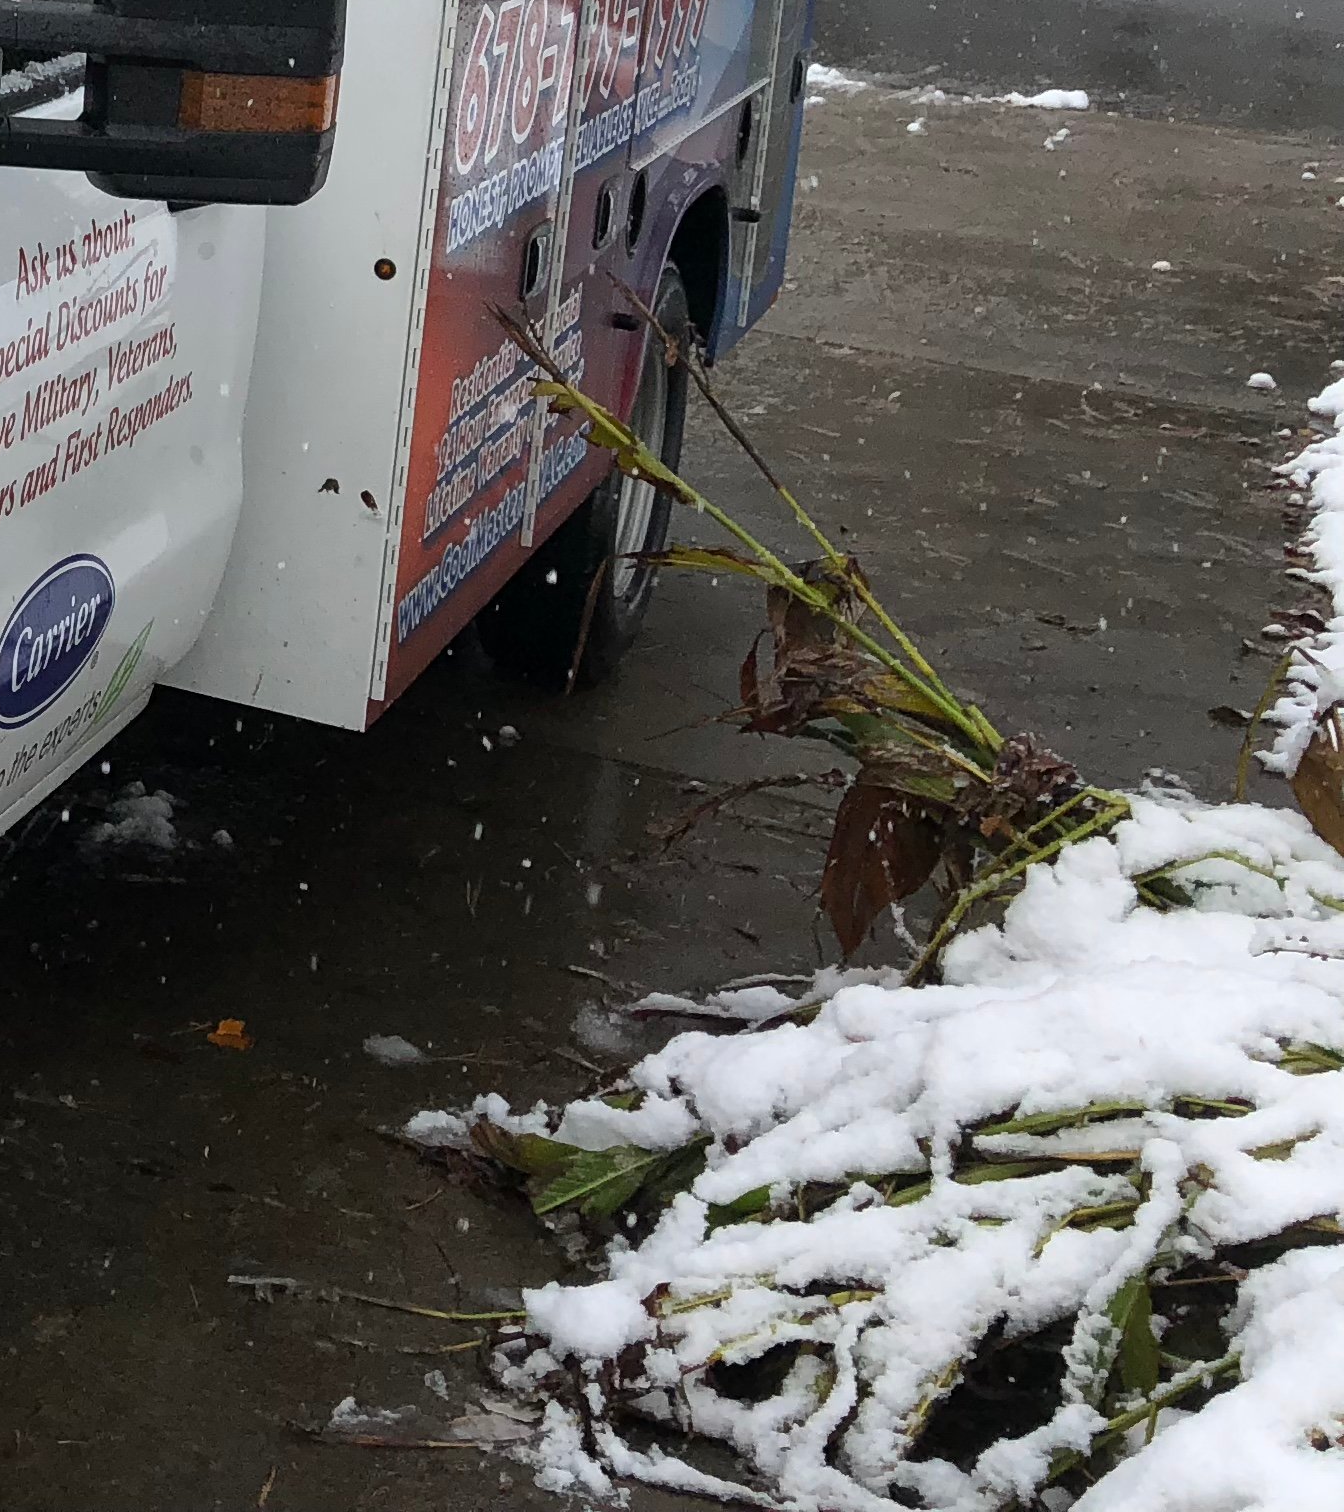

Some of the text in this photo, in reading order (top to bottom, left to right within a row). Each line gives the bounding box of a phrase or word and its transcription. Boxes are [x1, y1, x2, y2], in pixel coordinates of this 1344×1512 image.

[15, 209, 136, 301] Ask us about:
[56, 276, 139, 352] Discounts
[140, 260, 168, 316] for
[19, 367, 99, 442] Military,
[107, 322, 177, 392] Veterans,
[20, 442, 61, 508] and
[61, 421, 103, 483] First
[103, 370, 193, 456] Responders.
[11, 592, 102, 693] Carrier
[6, 744, 39, 787] the
[38, 689, 102, 757] experts
